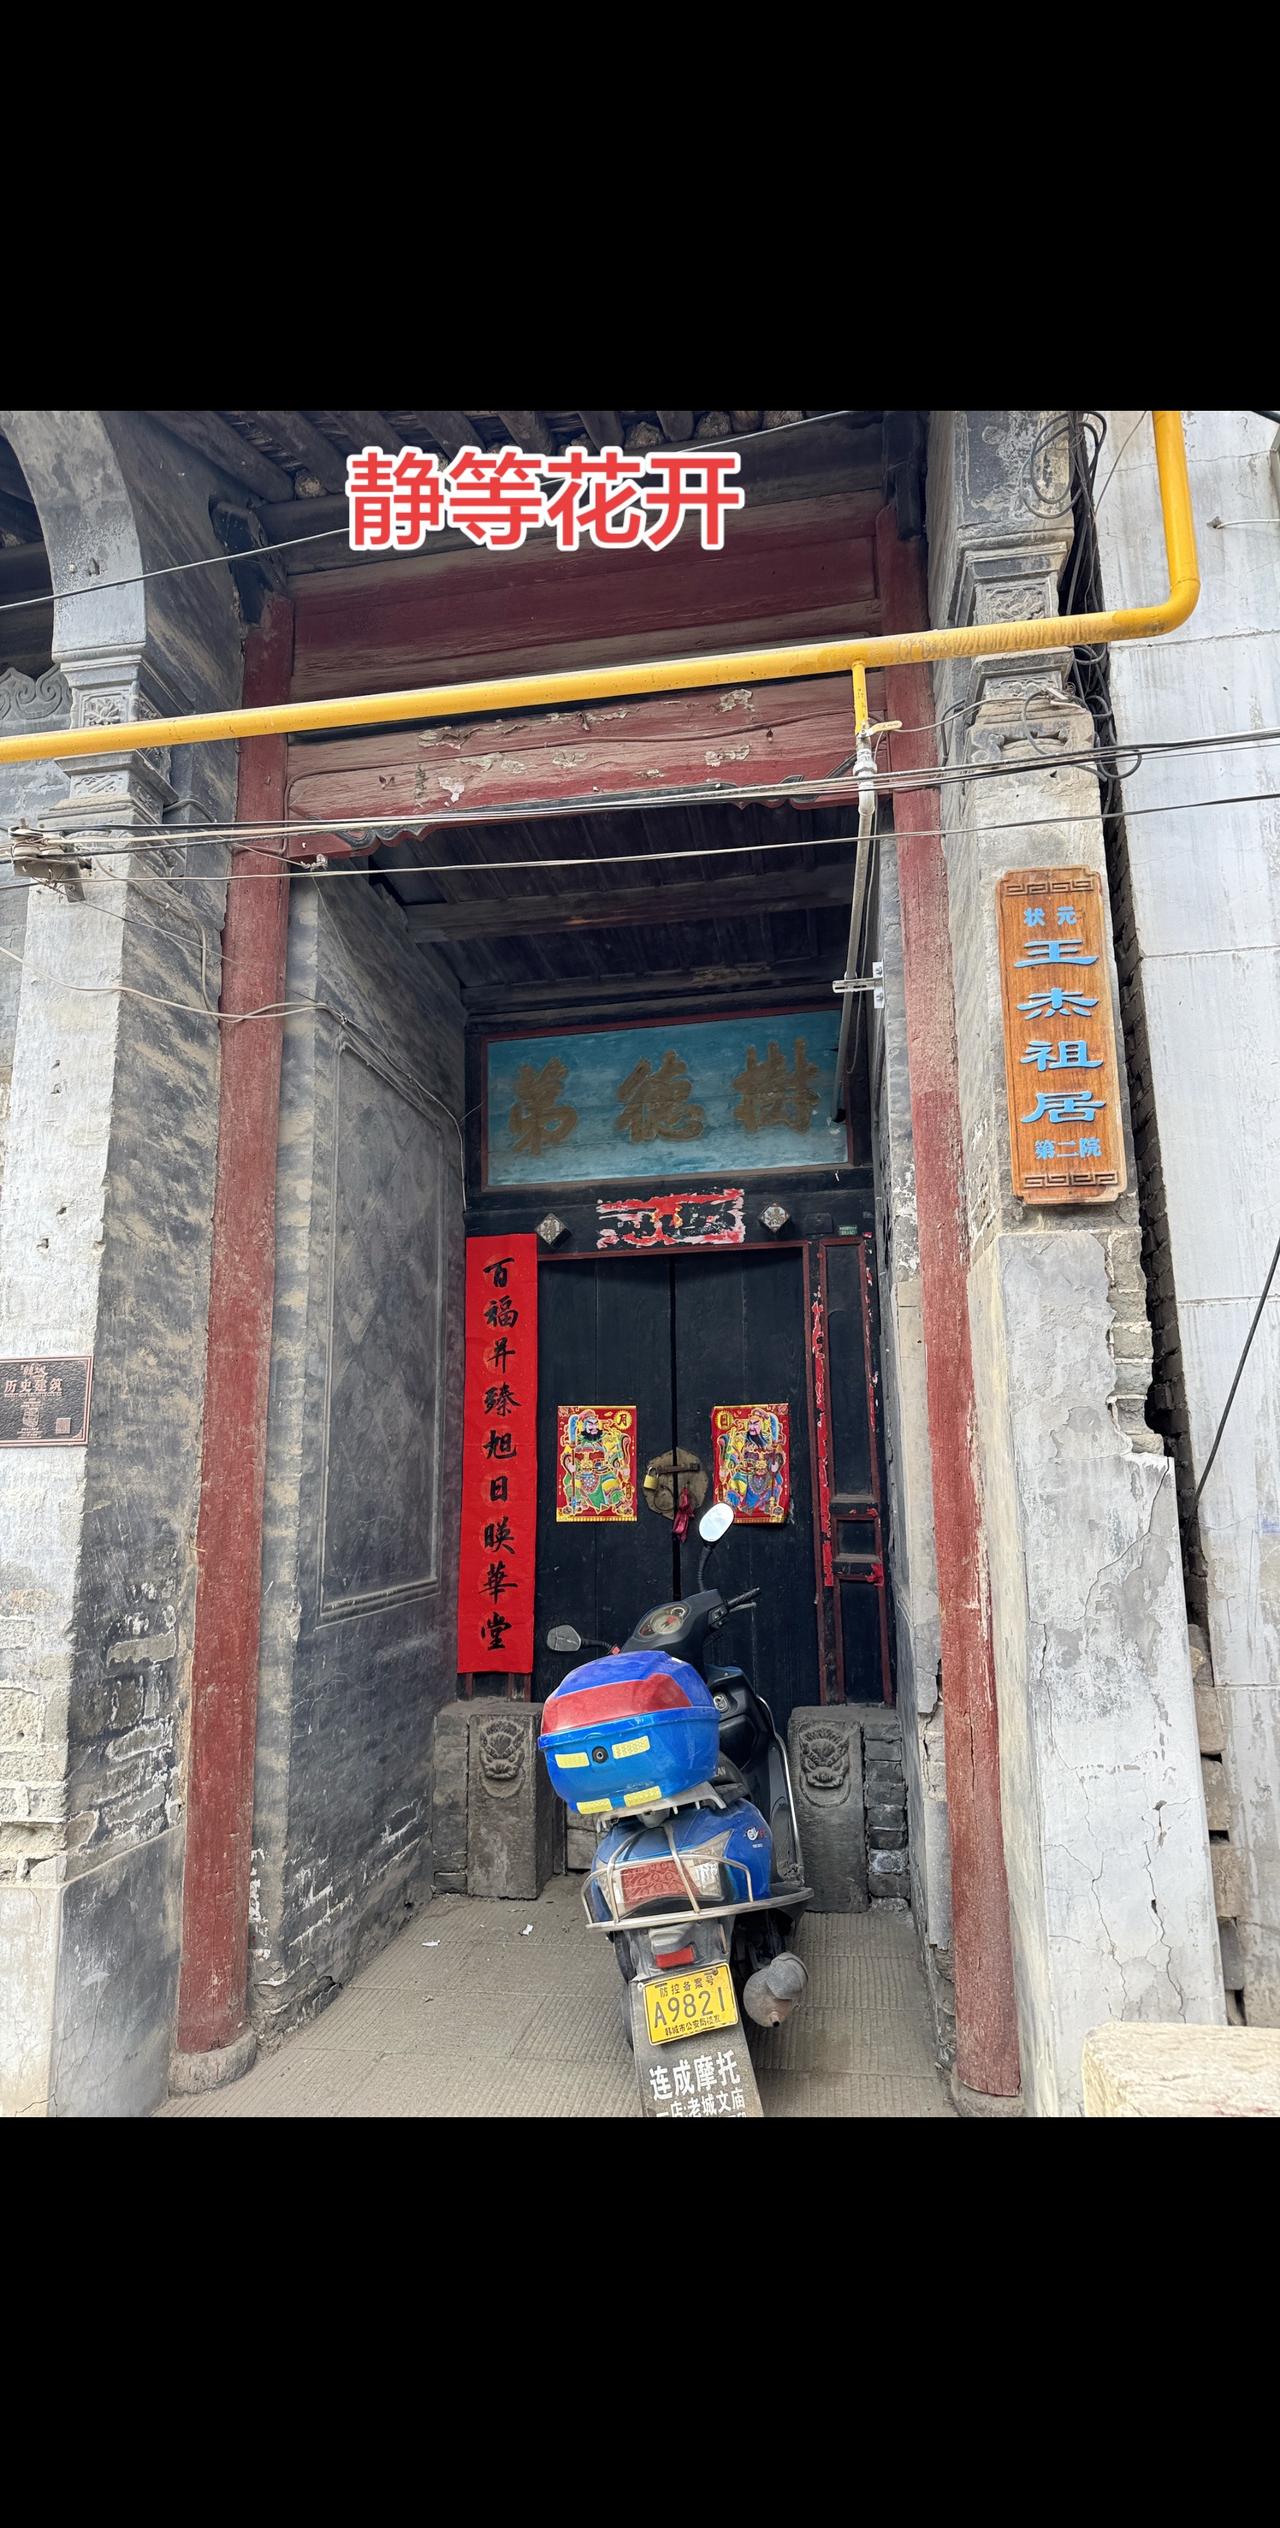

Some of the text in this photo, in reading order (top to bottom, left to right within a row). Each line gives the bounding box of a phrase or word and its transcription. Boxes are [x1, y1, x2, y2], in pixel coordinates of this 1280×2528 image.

[1023, 906, 1078, 927] 状元
[1013, 939, 1105, 1123] 王杰祖居
[1034, 1137, 1103, 1160] 第二院
[4, 1377, 63, 1393] 历史建筑
[654, 1986, 725, 2029] A9821
[649, 2050, 741, 2101] 连成摩托
